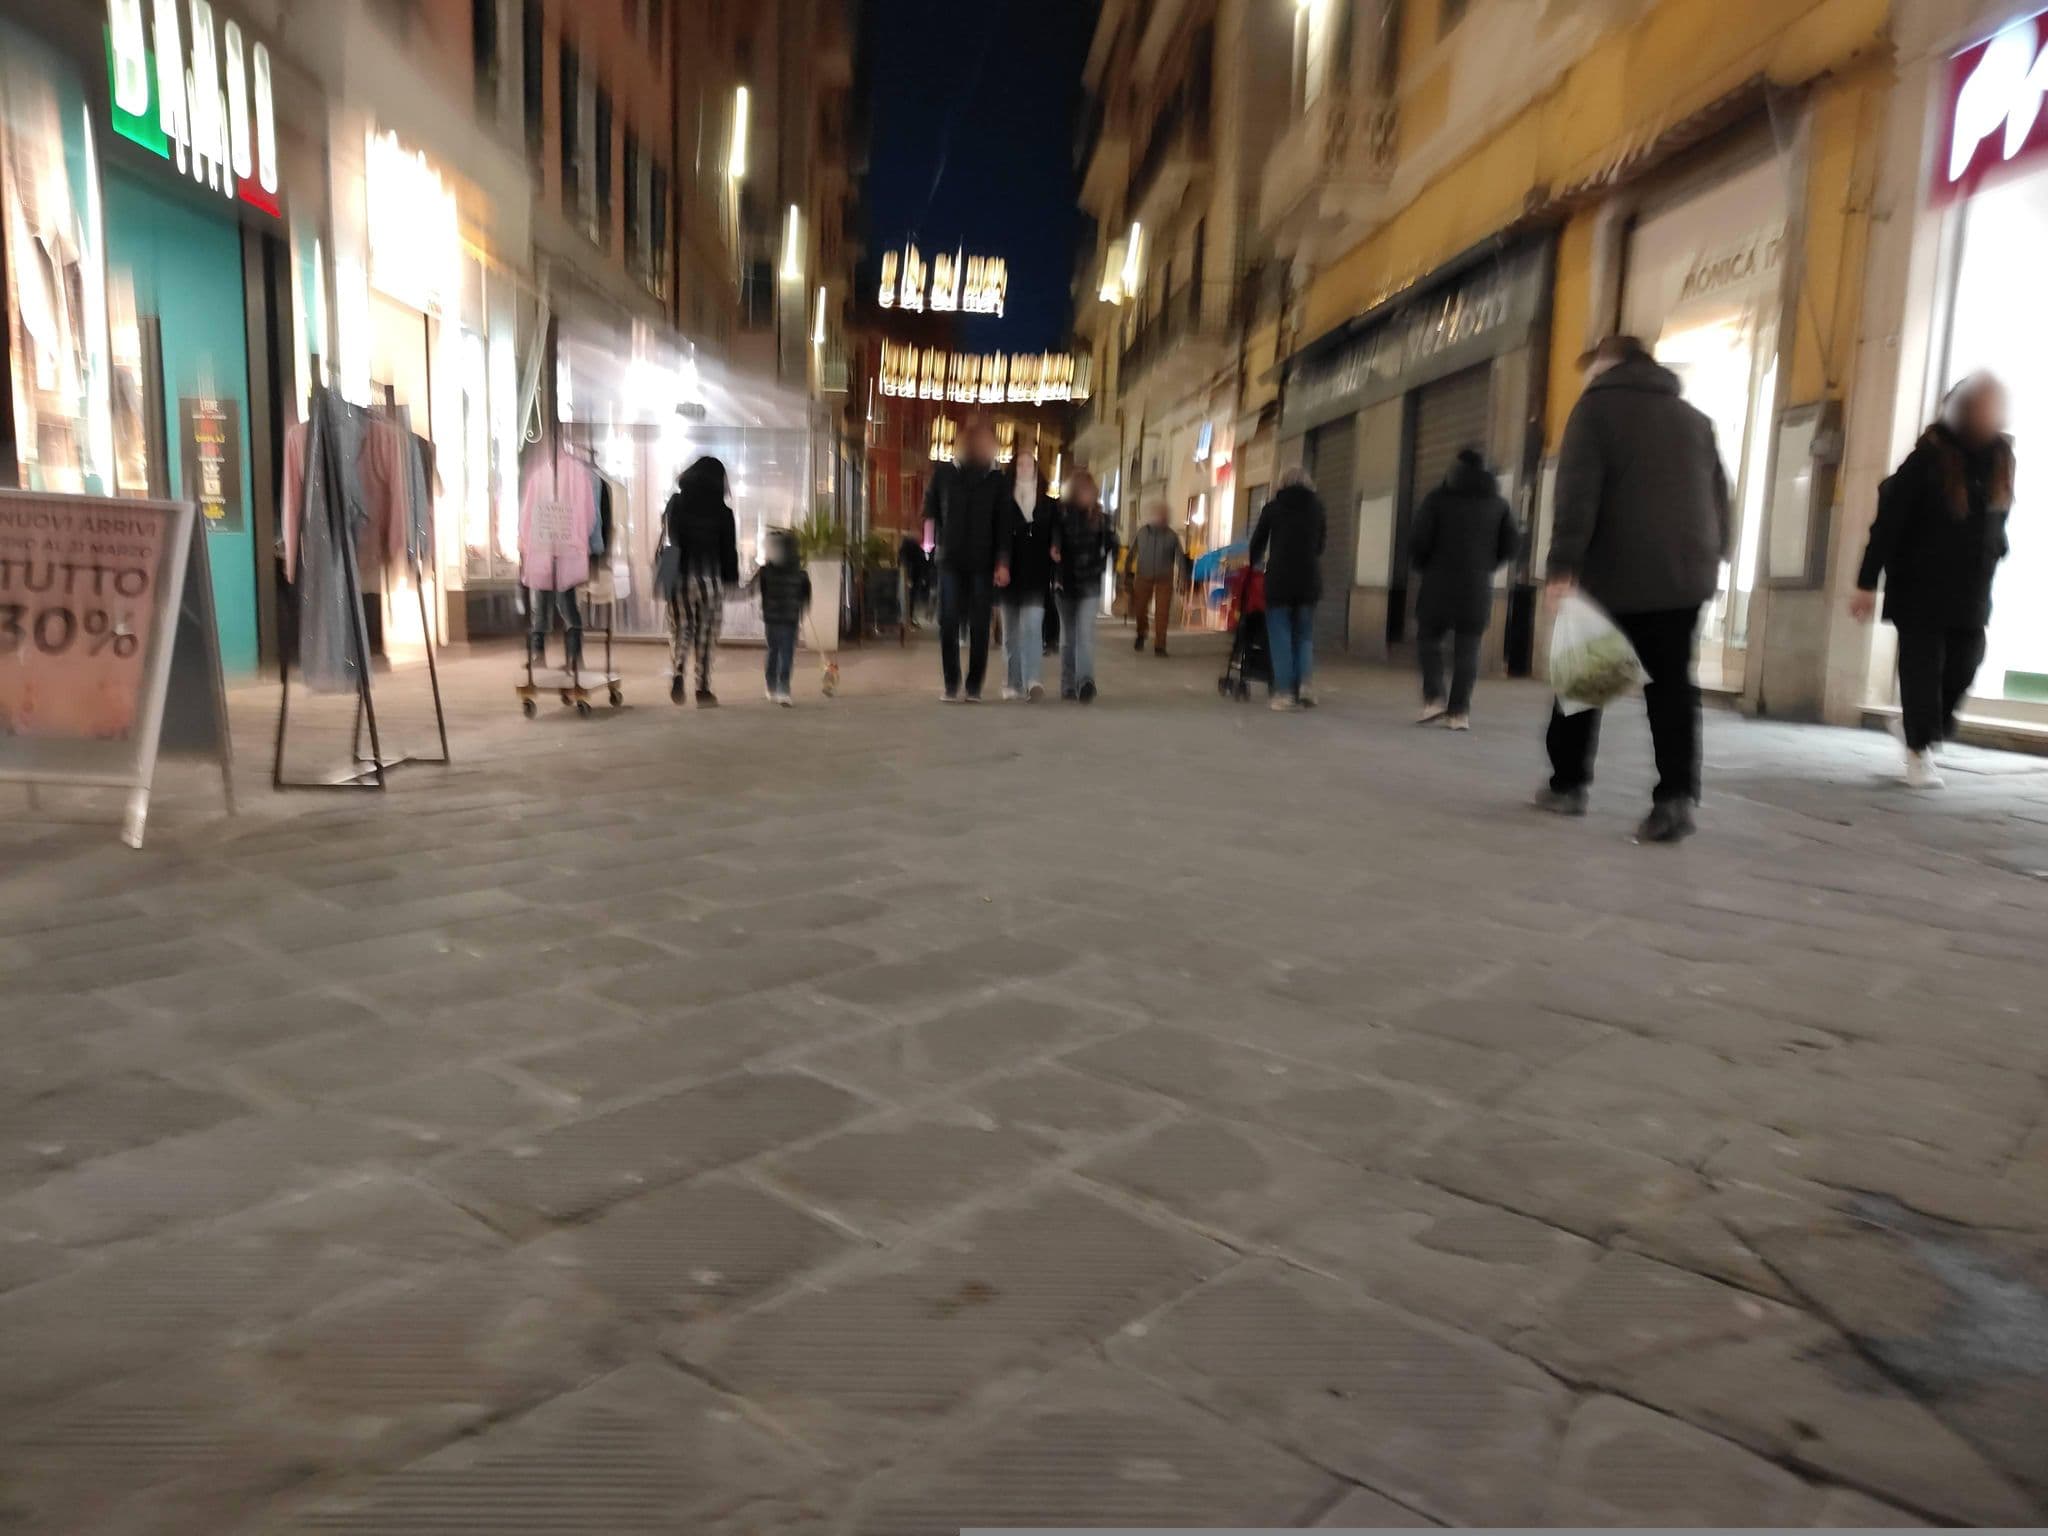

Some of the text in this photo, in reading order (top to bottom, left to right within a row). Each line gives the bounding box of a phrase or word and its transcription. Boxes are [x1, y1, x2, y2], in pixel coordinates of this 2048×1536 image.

[79, 516, 156, 537] ARRIVI
[0, 559, 149, 598] TUTTO
[0, 603, 139, 659] 30%
